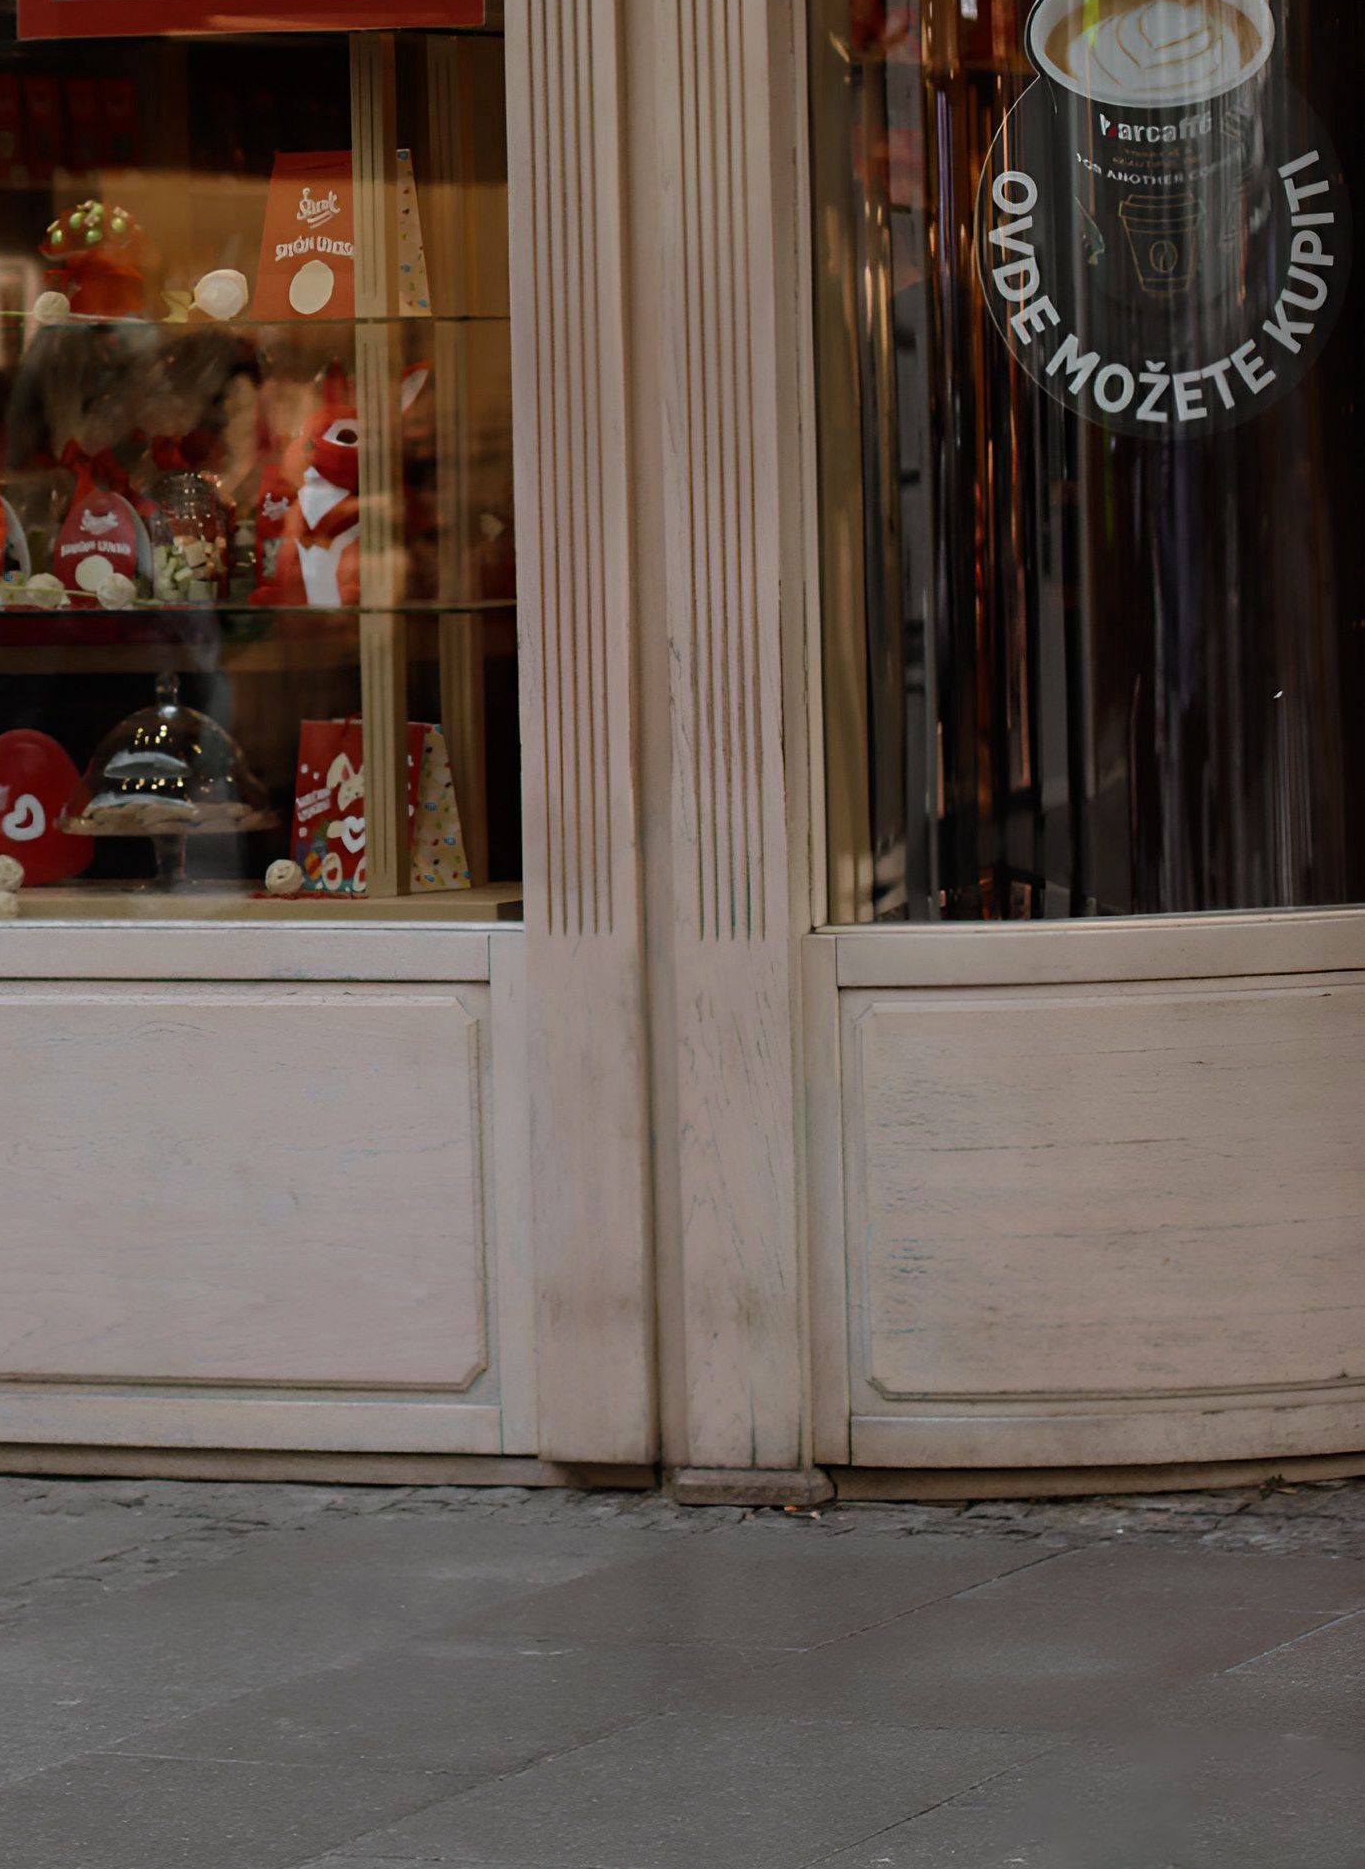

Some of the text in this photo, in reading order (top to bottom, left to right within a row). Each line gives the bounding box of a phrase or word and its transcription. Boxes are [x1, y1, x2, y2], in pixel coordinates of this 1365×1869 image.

[988, 150, 1336, 423] OVDE MOŽETE KUPITI
